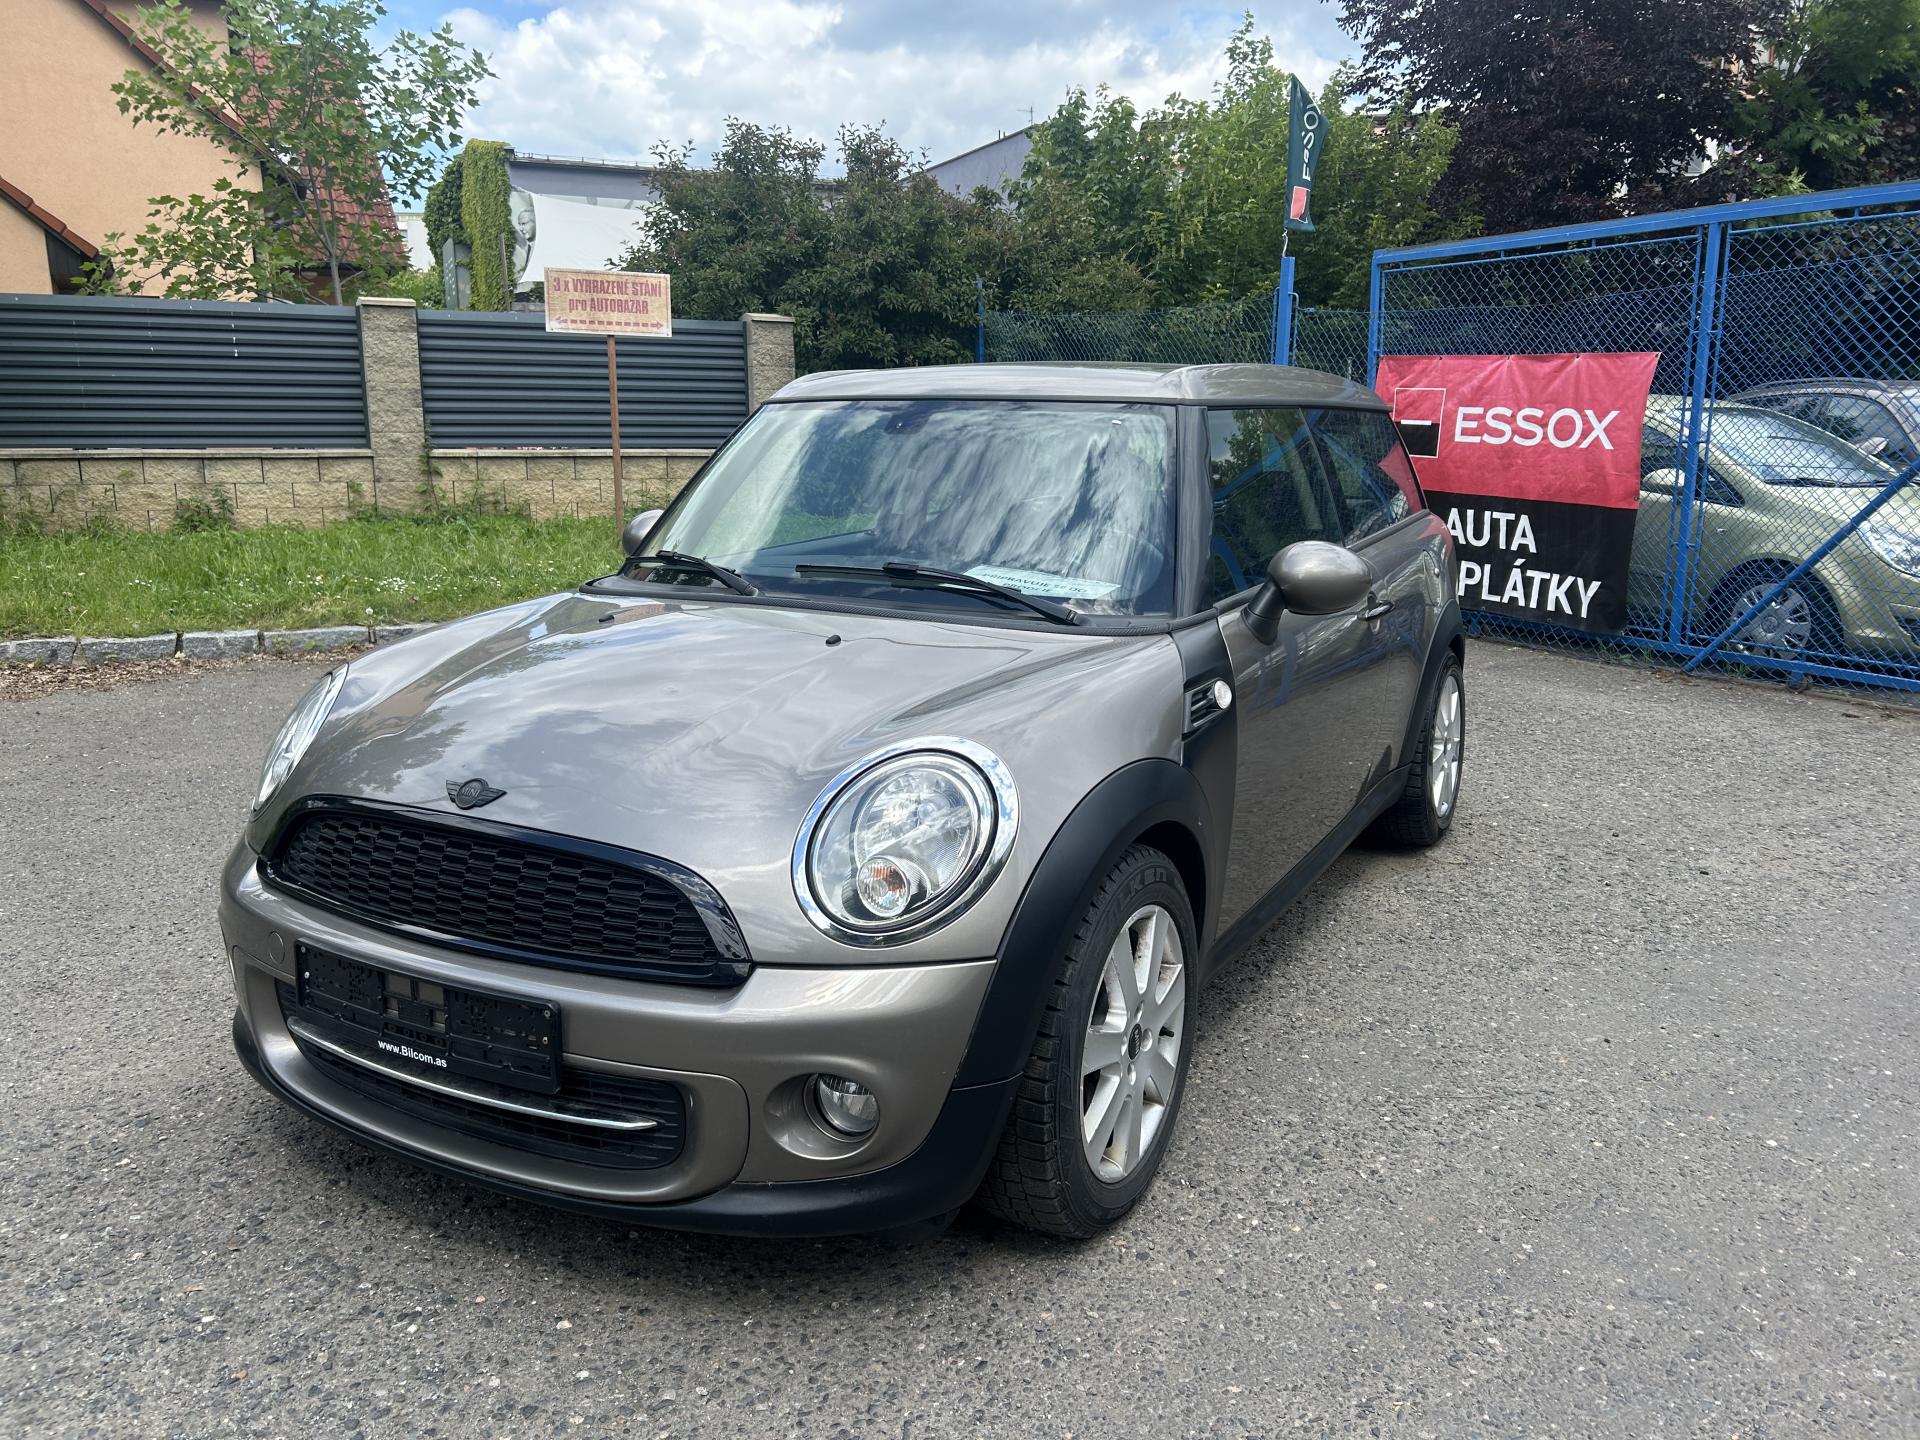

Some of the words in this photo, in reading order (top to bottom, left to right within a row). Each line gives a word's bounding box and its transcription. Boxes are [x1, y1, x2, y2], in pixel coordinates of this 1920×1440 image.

[553, 277, 561, 292] 3
[563, 281, 570, 293] x
[572, 278, 629, 296] VYHRAZENÉ
[631, 280, 662, 298] STÁNÍ
[569, 299, 587, 313] pro
[590, 298, 649, 315] AUTOBAZAR
[1454, 406, 1620, 450] ESSOX
[1447, 507, 1537, 553] AUTA
[1457, 558, 1602, 619] PLÁTKY
[377, 1040, 448, 1068] www.Bilcom.as
